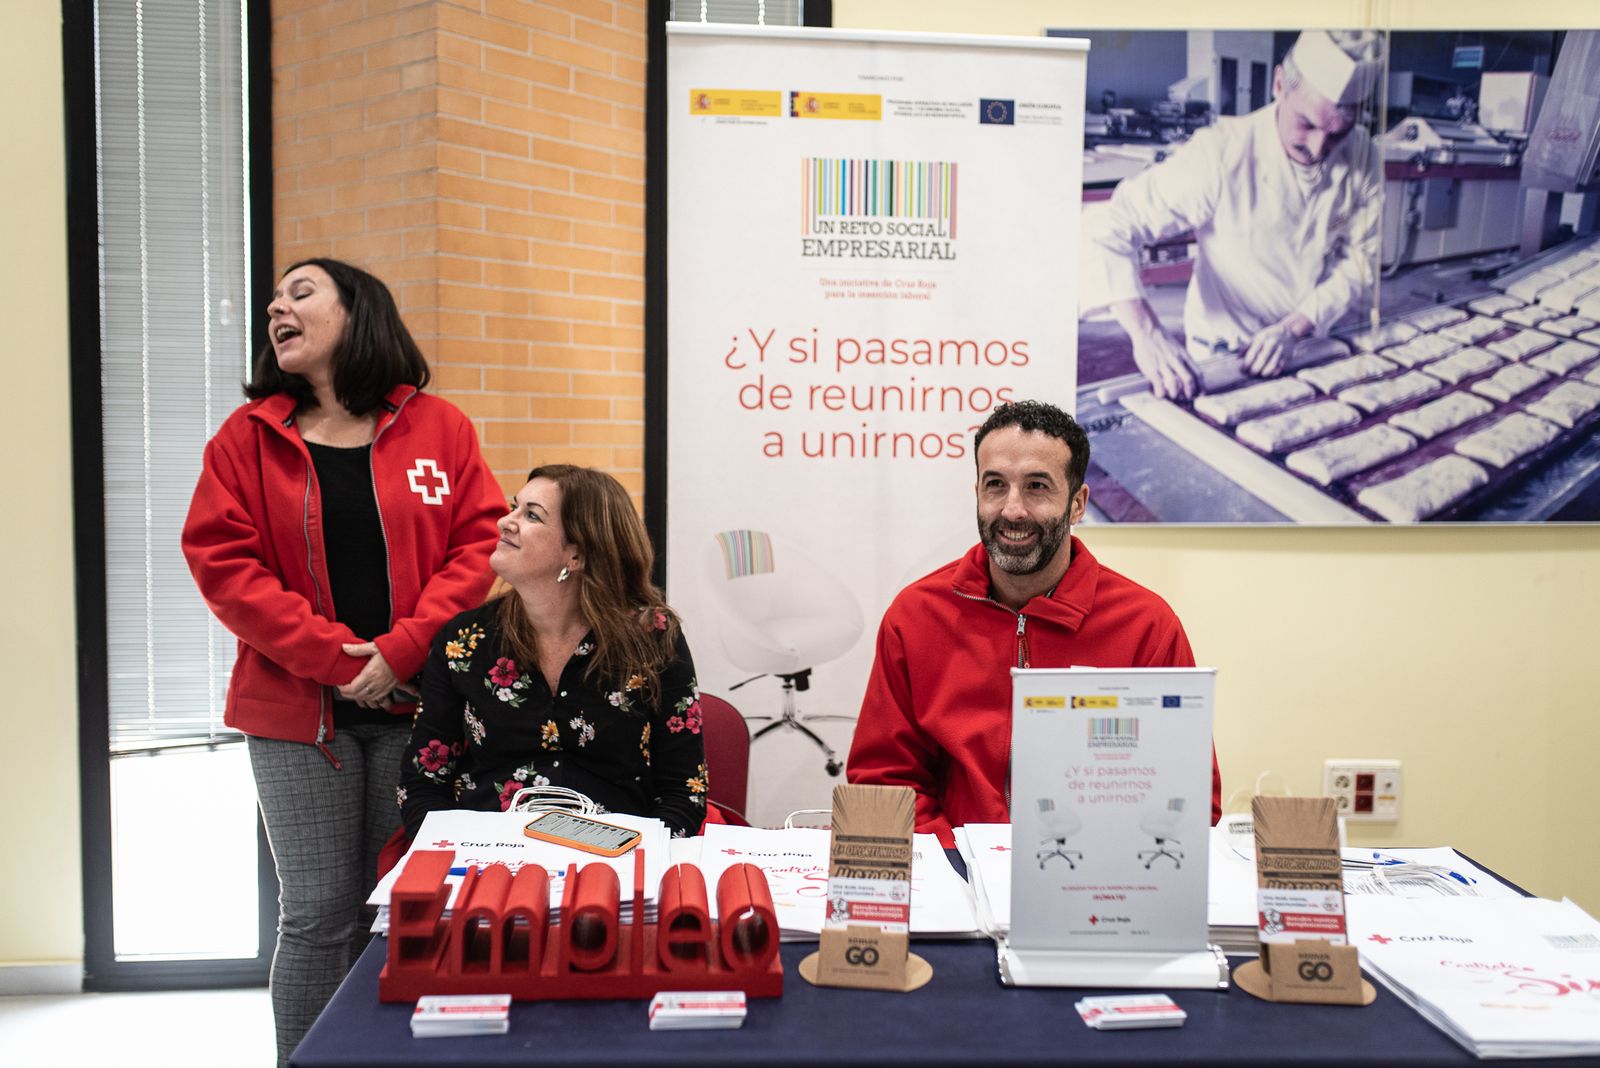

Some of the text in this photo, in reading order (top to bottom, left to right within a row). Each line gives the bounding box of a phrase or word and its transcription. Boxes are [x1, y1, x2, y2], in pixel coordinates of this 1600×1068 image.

[813, 220, 947, 237] UN RETO SOCIAL
[801, 239, 957, 260] EMPRESARIAL
[819, 277, 836, 287] Una
[839, 277, 879, 287] iniciativa
[881, 278, 892, 288] de
[895, 277, 915, 288] Cruz
[824, 290, 844, 300] para
[724, 327, 1030, 373] ¿Y si pasamos
[738, 374, 793, 412] de
[763, 431, 784, 458] a
[1064, 766, 1157, 779] ¿Y si pasamos
[1068, 779, 1152, 790] de reunirnos
[1077, 792, 1146, 803] a unirnos?
[494, 841, 525, 849] Roja
[387, 849, 781, 977] Empleo
[1399, 935, 1474, 944] Cruz Roja
[845, 945, 879, 966] GO
[1298, 961, 1333, 981] GO
